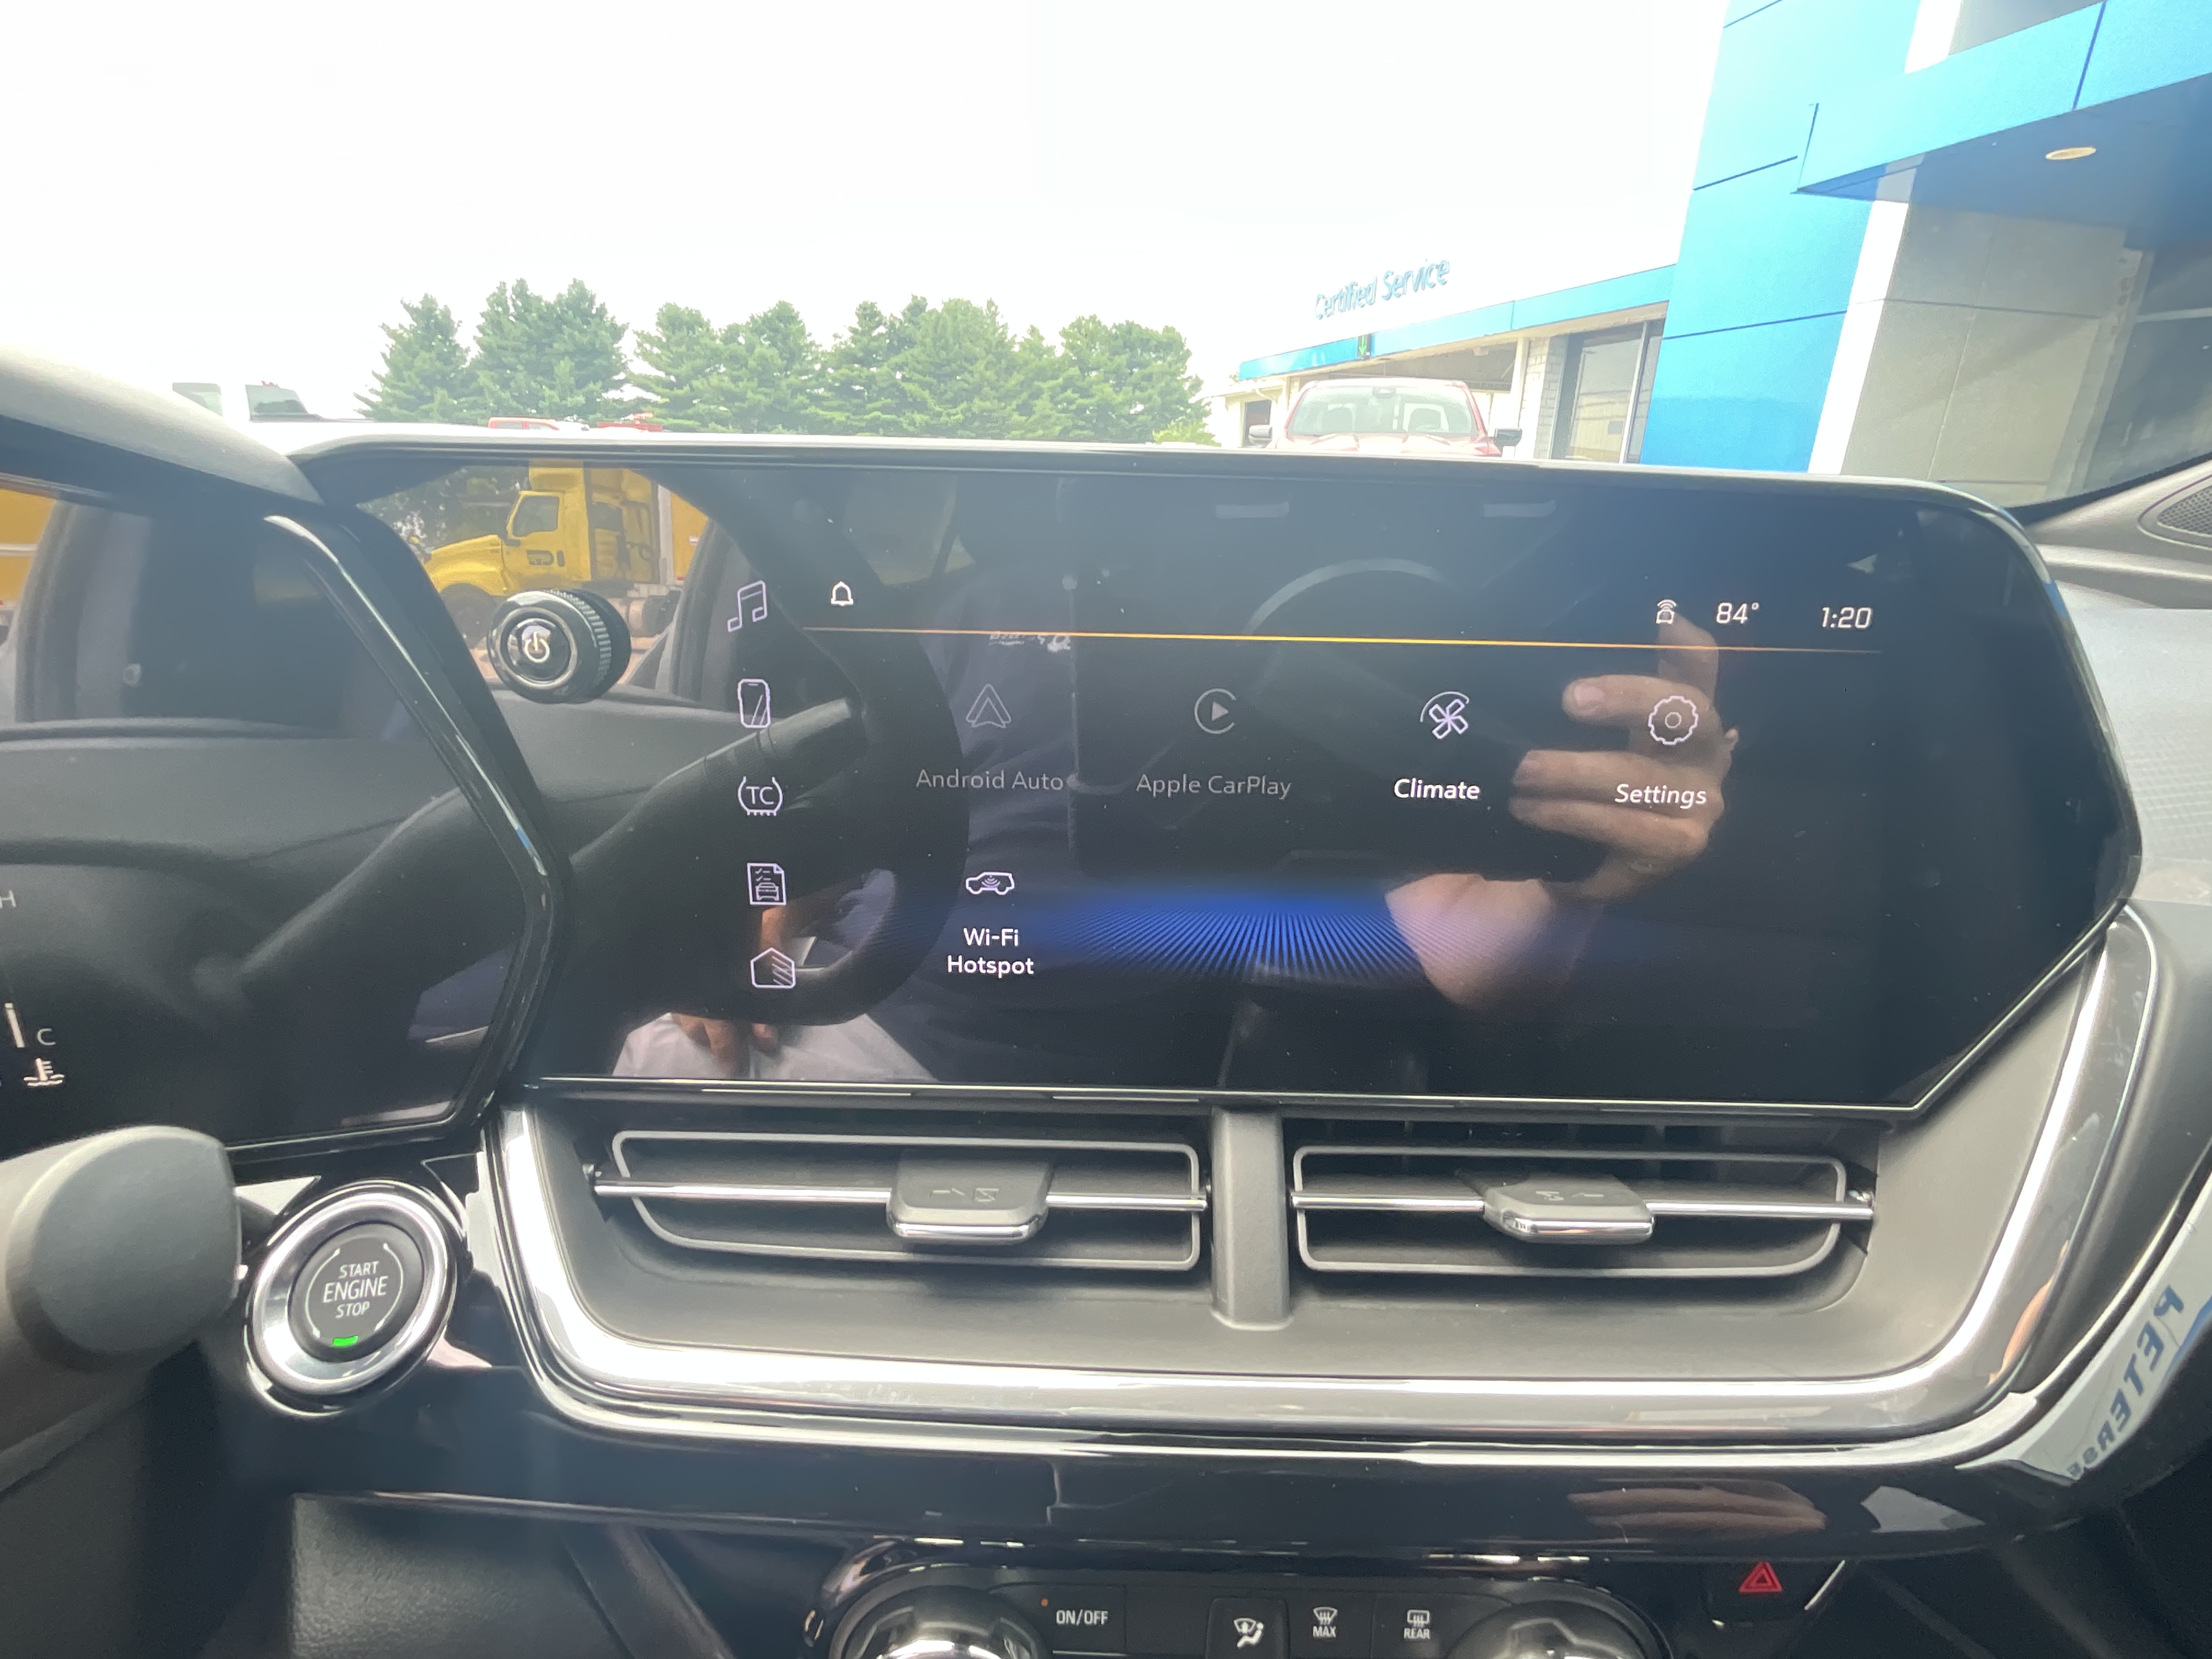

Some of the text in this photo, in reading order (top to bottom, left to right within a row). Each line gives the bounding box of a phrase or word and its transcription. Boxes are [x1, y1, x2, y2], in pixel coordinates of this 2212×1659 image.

[1315, 259, 1450, 320] Certified Service
[1820, 606, 1873, 629] 1:20
[916, 769, 1064, 792] Android Auto
[1136, 774, 1292, 800] Apple CarPlay
[1393, 777, 1481, 801] Climate
[746, 786, 774, 805] TC
[1615, 783, 1708, 809] Settings
[963, 928, 1020, 947] Wi-Fi
[946, 955, 1035, 979] Hotspot
[37, 1028, 56, 1046] C
[338, 1261, 379, 1279] START
[323, 1276, 388, 1303] ENGINE
[335, 1301, 370, 1319] STOP
[1056, 1610, 1109, 1626] ON/OFF
[1312, 1626, 1337, 1638] MAX
[1403, 1627, 1431, 1639] REAR
